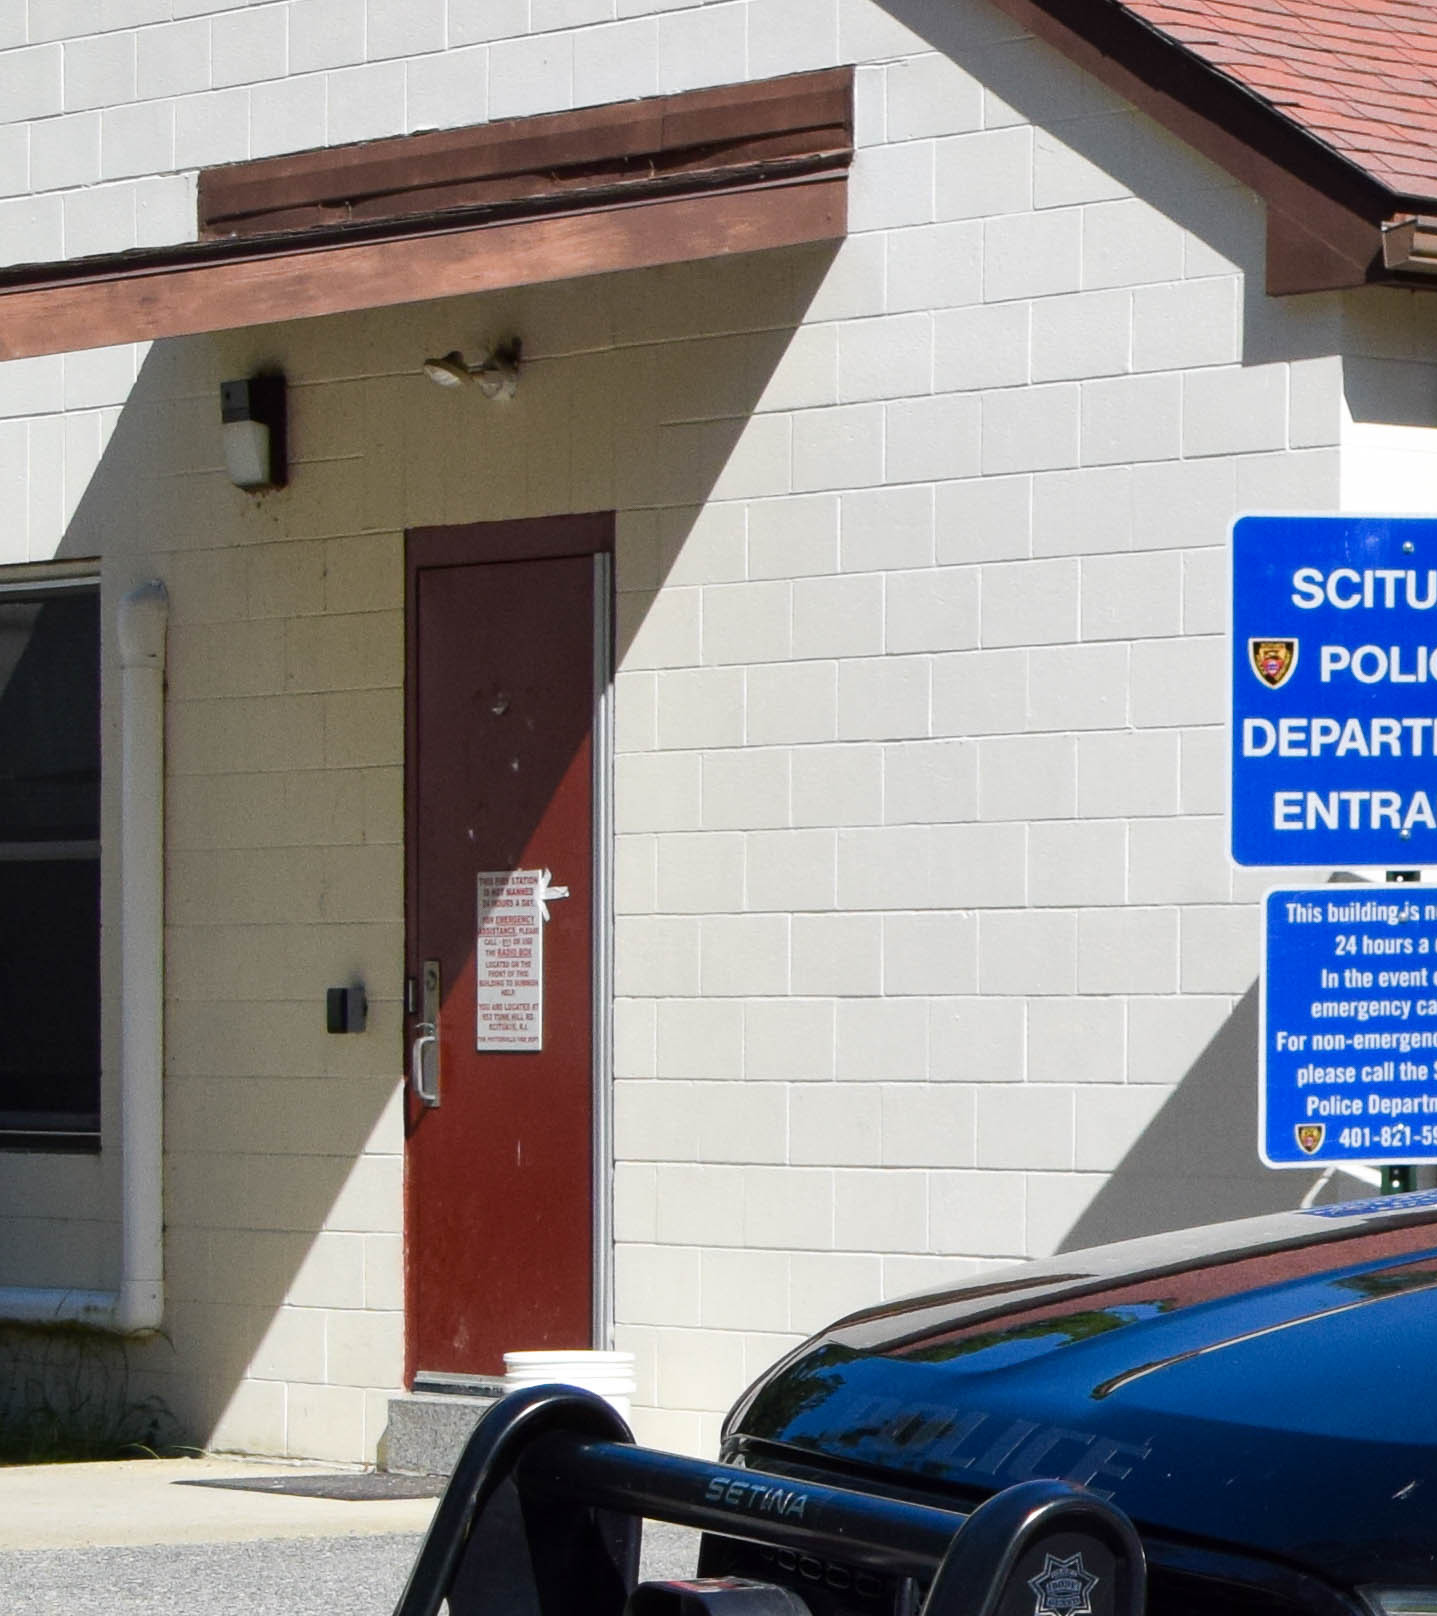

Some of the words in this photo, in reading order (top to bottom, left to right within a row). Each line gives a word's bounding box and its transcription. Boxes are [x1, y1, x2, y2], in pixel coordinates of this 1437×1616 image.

[1286, 903, 1323, 923] This
[1328, 902, 1400, 926] building
[1404, 902, 1420, 921] is
[1335, 935, 1357, 955] 24
[1362, 935, 1414, 954] hours
[1419, 938, 1430, 954] a
[1321, 969, 1339, 989] In
[1344, 968, 1373, 988] the
[1378, 968, 1428, 988] event
[1311, 1000, 1412, 1021] emergency
[1276, 1031, 1307, 1052] For
[1297, 1063, 1356, 1088] please
[1361, 1062, 1395, 1082] call
[1400, 1062, 1429, 1081] the
[1306, 1096, 1363, 1117] Police
[705, 1476, 809, 1520] SETINA
